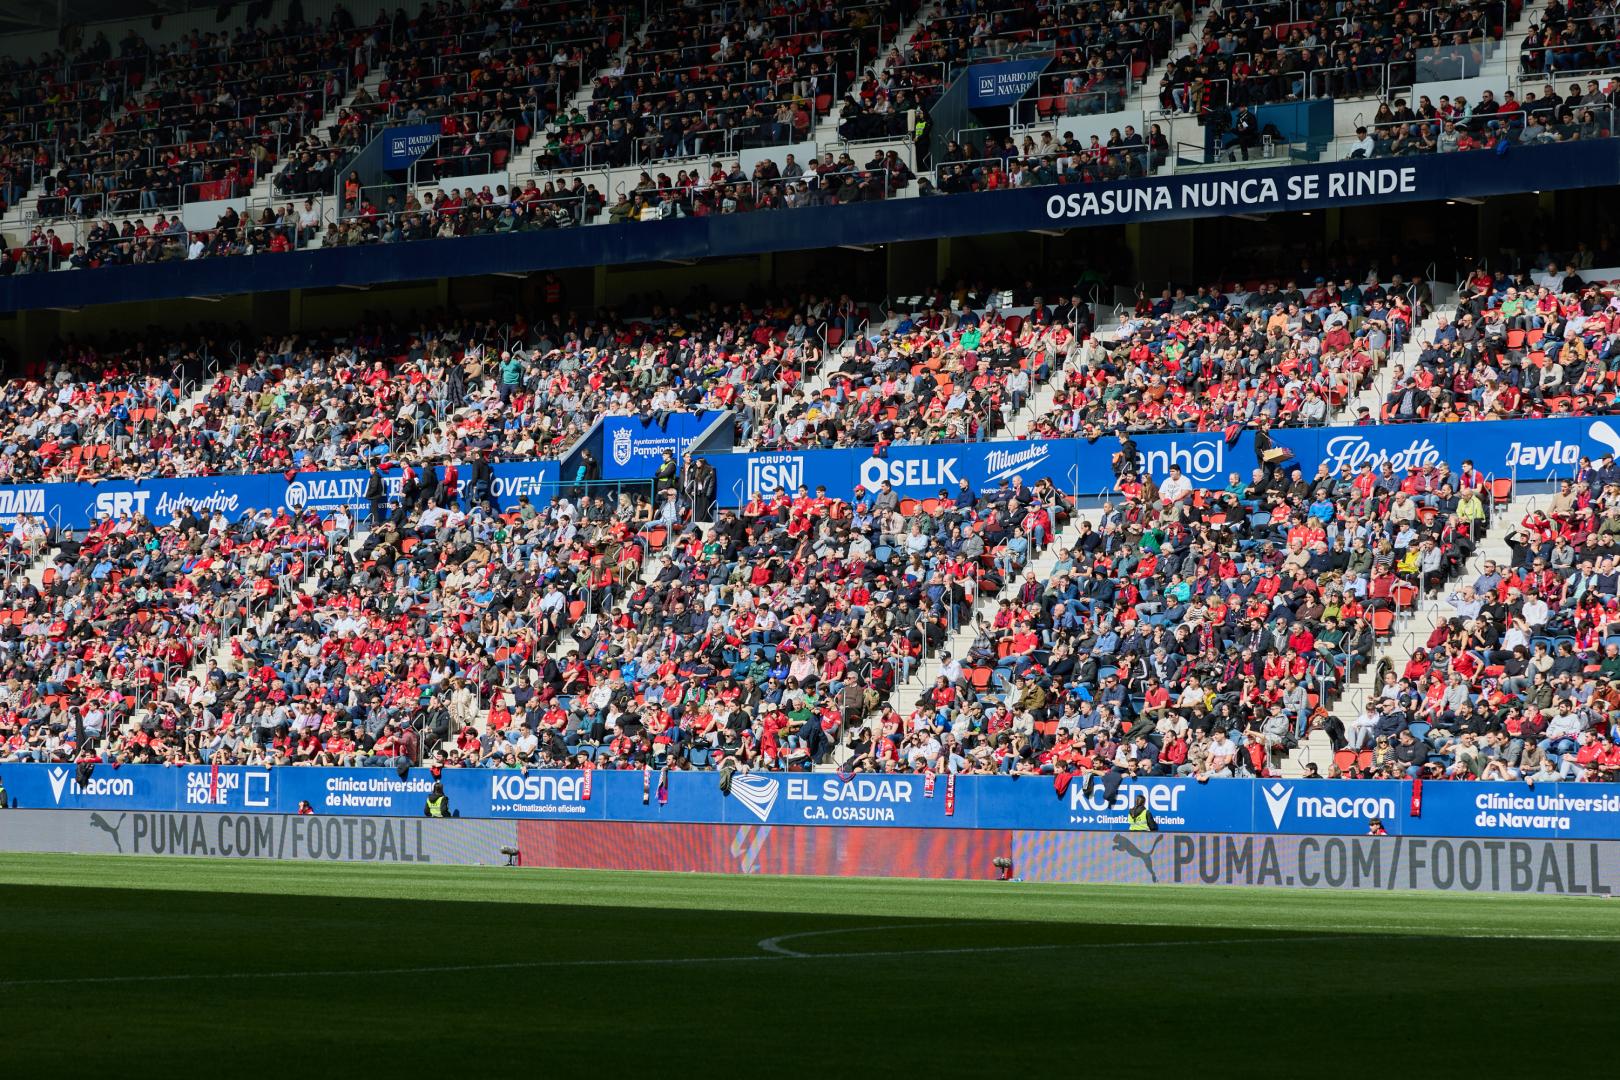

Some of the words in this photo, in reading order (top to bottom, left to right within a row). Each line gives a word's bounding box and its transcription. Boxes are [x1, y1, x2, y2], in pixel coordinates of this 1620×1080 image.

[981, 79, 993, 89] DN
[998, 72, 1027, 84] DIARIO
[394, 140, 405, 150] DN
[408, 135, 431, 144] DIARIO
[1046, 186, 1173, 219] OSASUNA
[1181, 178, 1280, 209] NUNCA
[1287, 174, 1320, 201] SE
[1328, 167, 1416, 198] RINDE
[760, 455, 792, 464] GRUPO
[984, 443, 1049, 475] Milwaukee
[1321, 435, 1444, 477] Florette
[1506, 440, 1580, 471] Jaylo
[754, 464, 797, 492] ISN
[96, 490, 150, 519] SRT
[70, 778, 134, 796] macron
[187, 771, 239, 789] SALOKI
[325, 777, 367, 792] Clínica
[787, 779, 821, 800] EL
[823, 779, 913, 802] SADAR
[325, 793, 341, 806] de
[342, 794, 392, 808] Navarra
[513, 803, 557, 813] Climatización
[557, 804, 586, 813] eficiente
[1296, 797, 1396, 819] macron
[1475, 793, 1535, 811] Clínica
[1537, 793, 1620, 812] Universid
[803, 806, 829, 820] C.A.
[832, 806, 895, 821] OSASUNA
[1152, 816, 1186, 825] ficiente
[1475, 811, 1497, 828] de
[1498, 813, 1571, 830] Navarra
[133, 813, 430, 862] PUMA.COM/FOOTBALL
[1173, 835, 1612, 894] PUMA.COM/FOOTBALL
